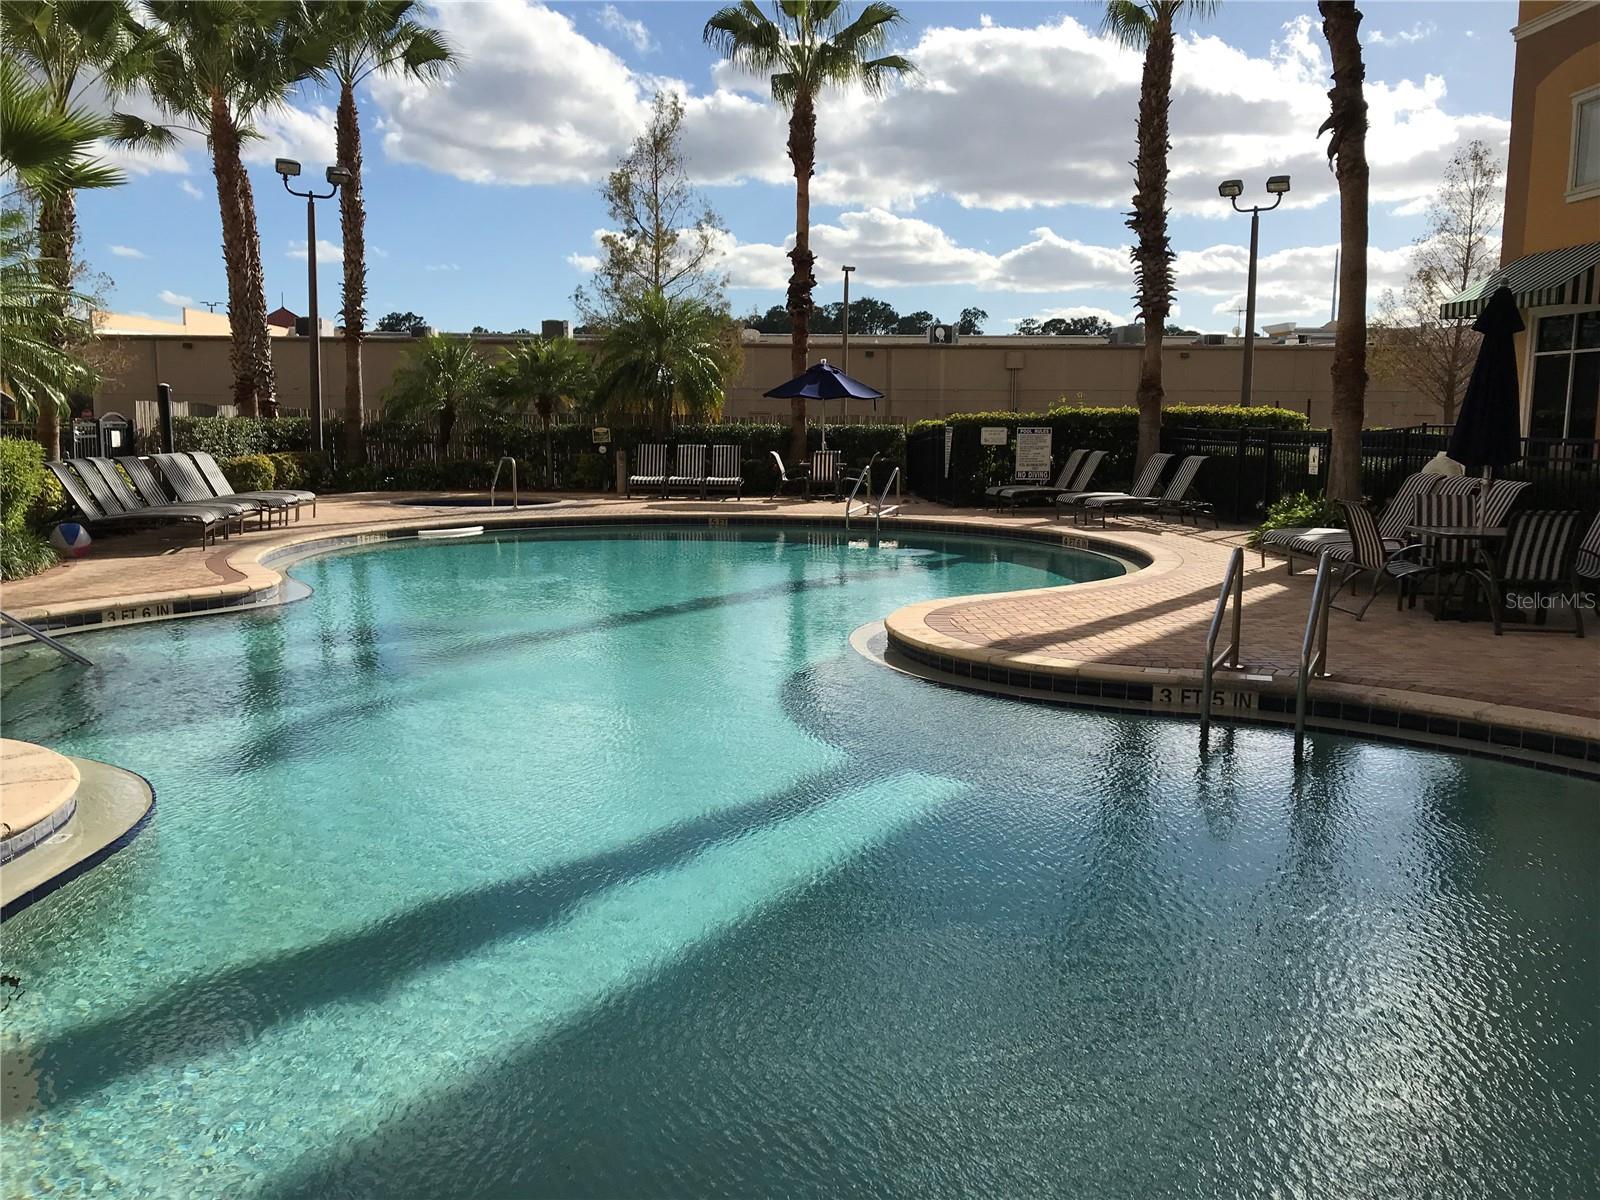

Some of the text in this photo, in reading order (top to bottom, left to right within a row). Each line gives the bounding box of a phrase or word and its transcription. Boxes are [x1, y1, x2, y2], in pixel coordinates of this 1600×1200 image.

[107, 605, 169, 621] 3 FT 6 IN
[1160, 688, 1251, 708] 3 FT 5 IN
